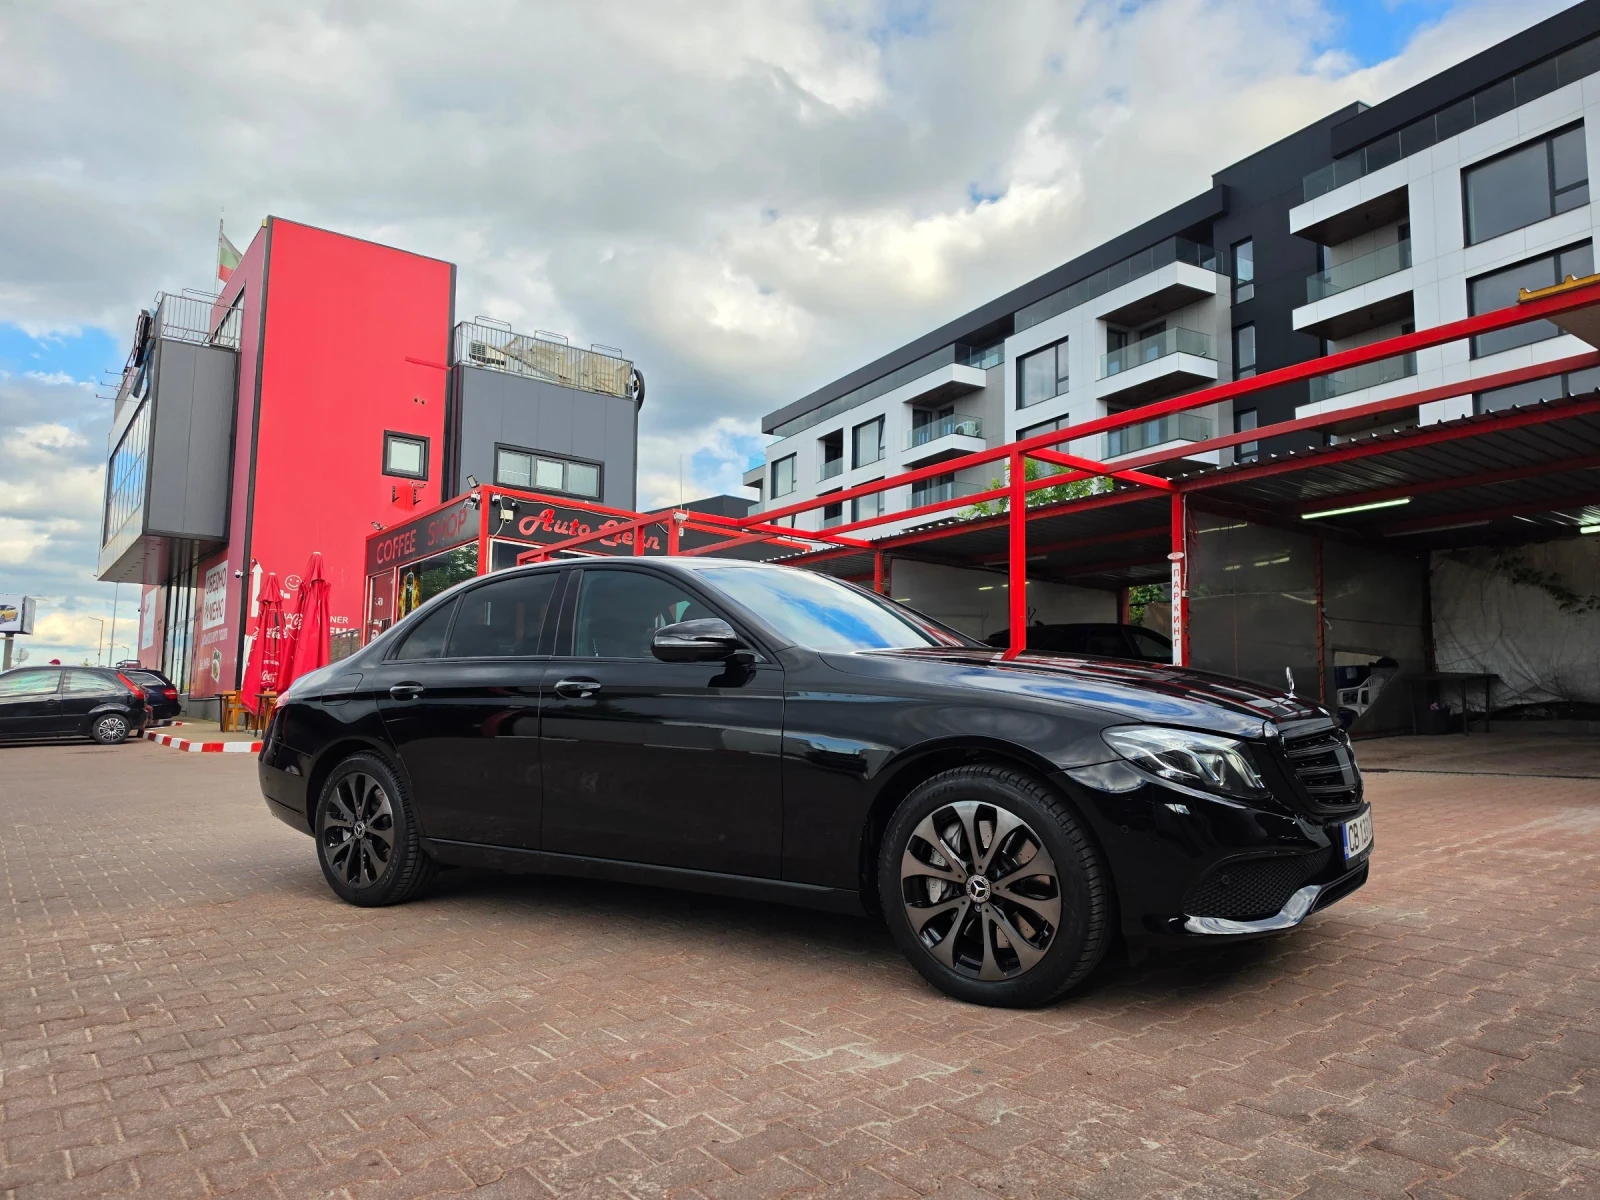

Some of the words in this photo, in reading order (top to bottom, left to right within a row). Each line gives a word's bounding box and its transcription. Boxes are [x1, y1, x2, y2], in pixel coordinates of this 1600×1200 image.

[376, 529, 417, 564] COFFEE
[427, 507, 467, 546] SHOP
[518, 508, 591, 537] Auto
[1348, 822, 1360, 852] CB
